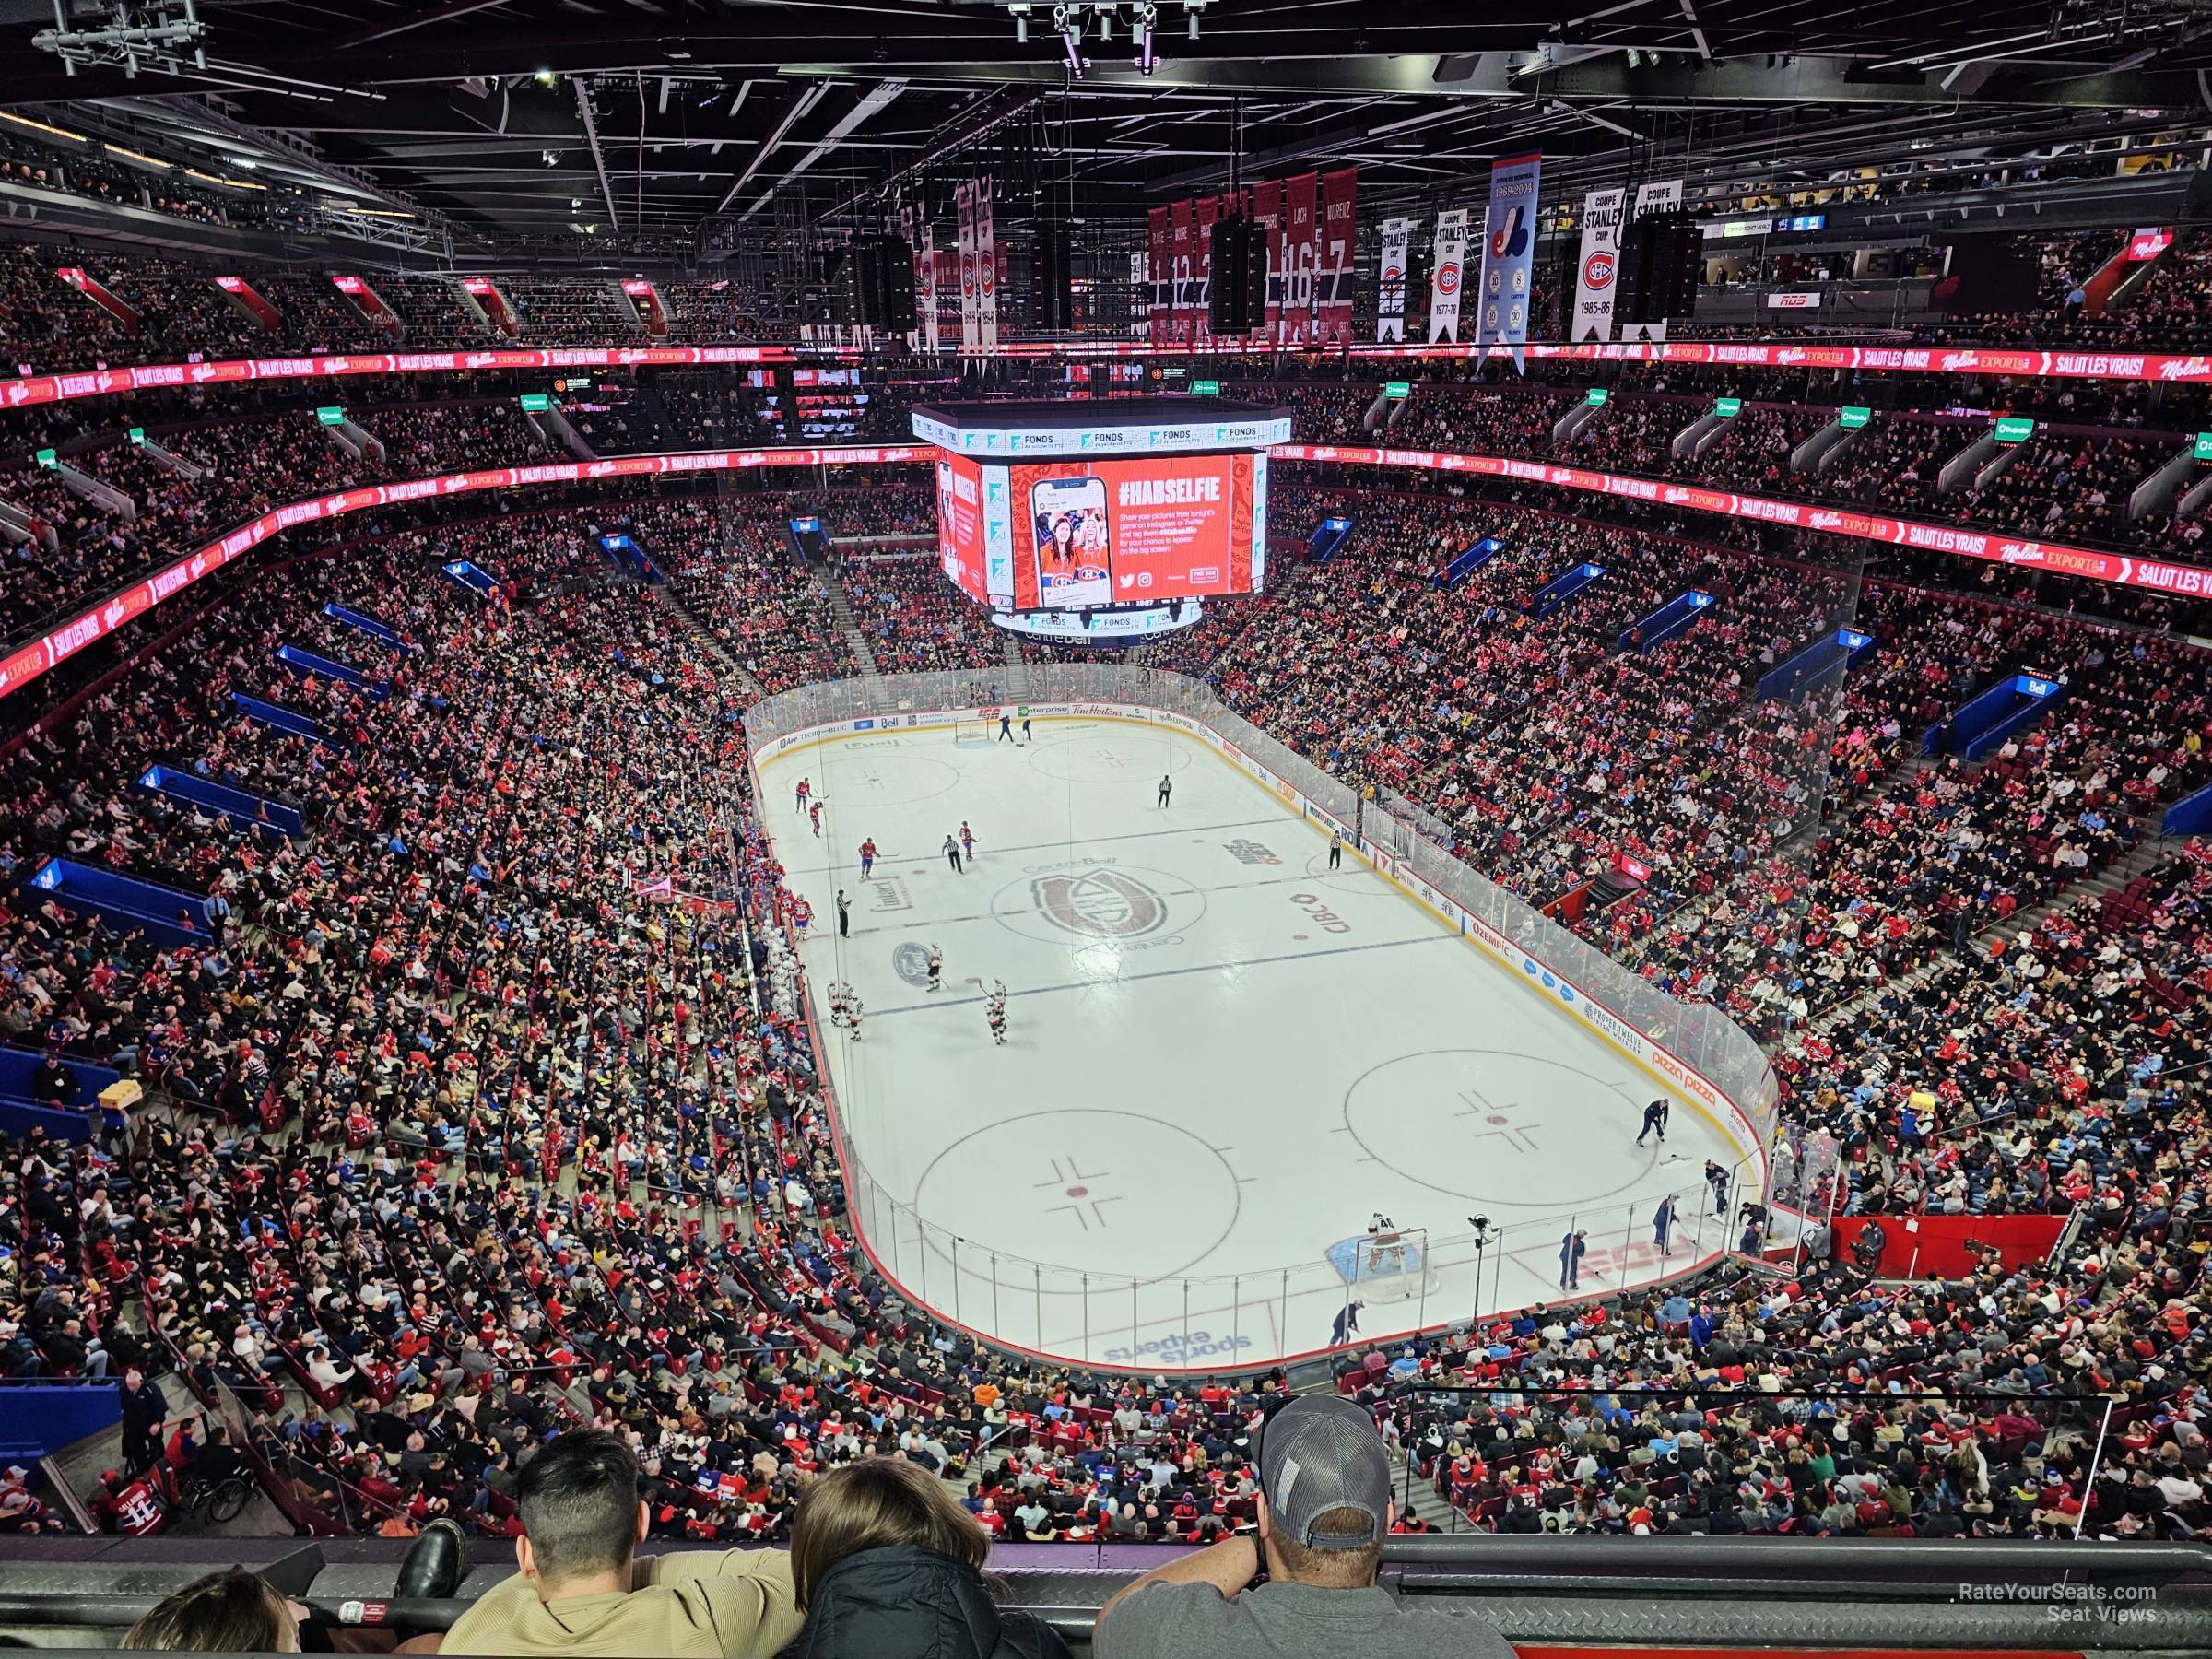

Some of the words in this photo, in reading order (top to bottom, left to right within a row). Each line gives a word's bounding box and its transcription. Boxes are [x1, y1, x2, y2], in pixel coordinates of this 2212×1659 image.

[1496, 182, 1534, 197] 1969-2004
[1648, 188, 1670, 200] COUPE
[1596, 195, 1616, 206] COUPE
[1294, 207, 1307, 225] LACH
[1327, 201, 1350, 221] MORENZ
[1585, 208, 1623, 229] STANLEY
[1445, 215, 1460, 224] COUPE
[1383, 232, 1406, 249] STANLEY
[1439, 226, 1466, 243] STANLEY
[1596, 231, 1608, 241] CUP
[1446, 245, 1454, 253] CUP
[1287, 241, 1312, 308] 16
[1329, 240, 1346, 308] 7
[1491, 276, 1499, 286] 10
[1517, 276, 1521, 284] 8
[1172, 255, 1189, 310] 12
[1582, 302, 1610, 313] 1985-86
[1780, 295, 1806, 306] RDS
[1436, 304, 1456, 315] 1977-78
[1489, 312, 1495, 321] 10
[1512, 312, 1521, 321] 30
[399, 356, 418, 369] SALUT
[419, 356, 431, 368] LES
[432, 354, 454, 368] VRAIS!
[553, 353, 572, 363] SALUT
[572, 352, 584, 363] LES
[585, 352, 606, 362] VRAIS!
[1718, 348, 1735, 360] SALUT
[1735, 348, 1747, 360] LES
[1747, 348, 1768, 361] VRAIS!
[1865, 351, 1888, 366] SALUT
[1888, 351, 1902, 366] LES
[1903, 352, 1929, 367] VRAIS!
[1941, 353, 1978, 371] Molson
[2056, 355, 2088, 374] SALUT
[2088, 357, 2107, 374] LES
[2108, 357, 2144, 375] VRAIS!
[2160, 359, 2210, 381] Molson
[1025, 435, 1053, 443] FONDS
[1095, 433, 1123, 441] FONDS
[823, 451, 842, 462] SALUT
[843, 451, 855, 461] LES
[856, 450, 878, 461] VRAIS!
[1285, 447, 1304, 458] VRAIS!
[671, 456, 691, 468] SALUT
[691, 456, 704, 467] LES
[704, 455, 727, 467] VRAIS!
[521, 468, 541, 481] SALUT
[541, 467, 554, 480] LES
[554, 466, 577, 479] VRAIS!
[1119, 477, 1220, 506] #HABSELFIE
[1152, 512, 1176, 520] pictures
[1742, 500, 1762, 516] SALUT
[1762, 502, 1775, 518] LES
[1776, 504, 1799, 522] VRAIS!
[1147, 520, 1176, 529] Instagram
[1809, 512, 1841, 529] Molson
[1159, 527, 1198, 535] #Habselfie
[1910, 527, 1937, 547] SALUT
[1937, 532, 1955, 549] LES
[1956, 534, 1986, 553] VRAIS!
[1139, 547, 1150, 555] big
[2000, 544, 2044, 563] Molson
[2138, 564, 2176, 588] SALUT
[2177, 569, 2200, 592] LES
[1041, 618, 1065, 627] FONDS
[1104, 618, 1130, 627] FONDS
[1848, 634, 1862, 647] Bell
[2029, 681, 2046, 695] Bell
[977, 708, 1002, 719] IGA
[1072, 704, 1088, 715] Tim
[1089, 706, 1122, 717] Hortons
[881, 717, 898, 728] Bell
[1282, 783, 1296, 802] SKIP
[1301, 905, 1351, 933] CIBC
[1612, 1030, 1641, 1054] WHISKEY
[1618, 1023, 1641, 1049] TWELVE
[1104, 1331, 1211, 1360] experts
[1159, 1336, 1252, 1364] sports
[119, 1490, 146, 1512] GALLAGHER
[128, 1500, 154, 1527] 11
